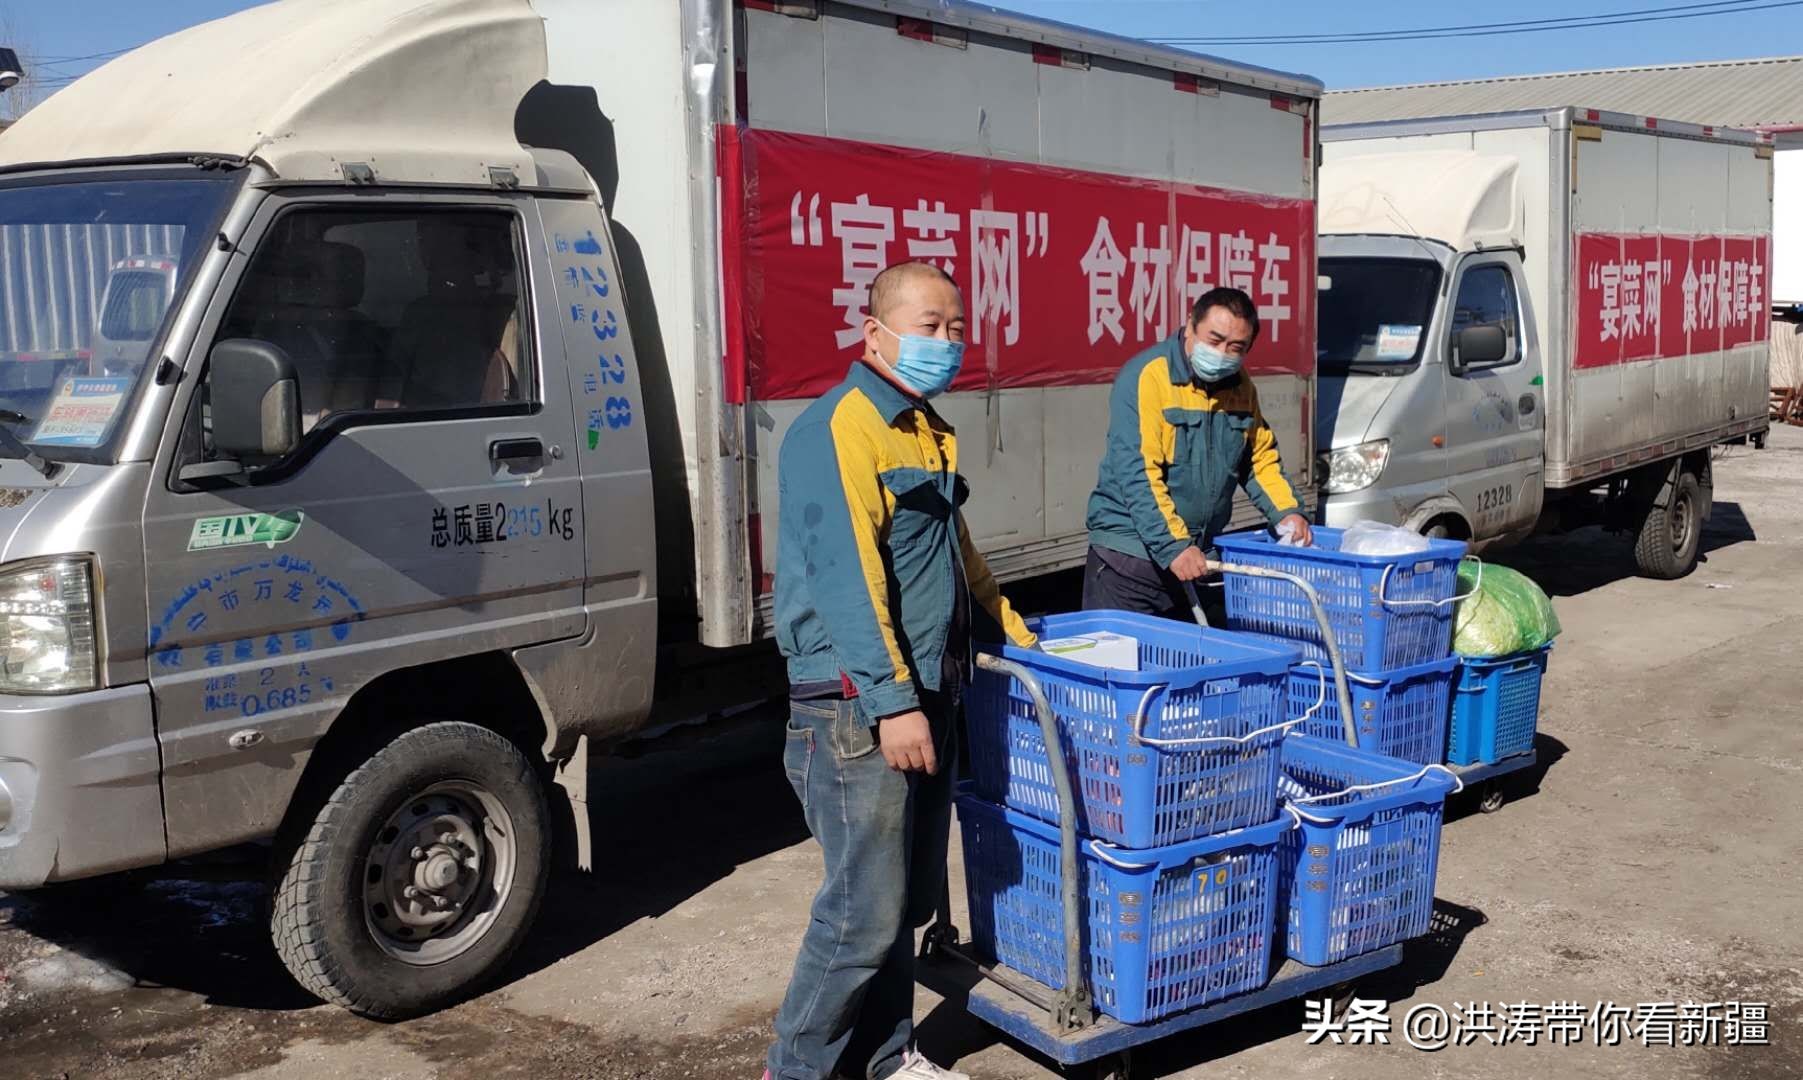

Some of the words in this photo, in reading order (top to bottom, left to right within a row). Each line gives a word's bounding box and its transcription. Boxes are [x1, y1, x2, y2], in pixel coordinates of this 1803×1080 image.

[1080, 216, 1291, 345] 食材保障车
[1588, 259, 1671, 342] “宴菜网”
[1682, 258, 1763, 334] 食材保障车
[574, 230, 632, 430] 12328
[431, 502, 542, 548] 总质量2215
[548, 498, 574, 541] kg
[1476, 484, 1512, 513] 12328
[241, 684, 312, 717] 0.685
[260, 667, 275, 686] 2
